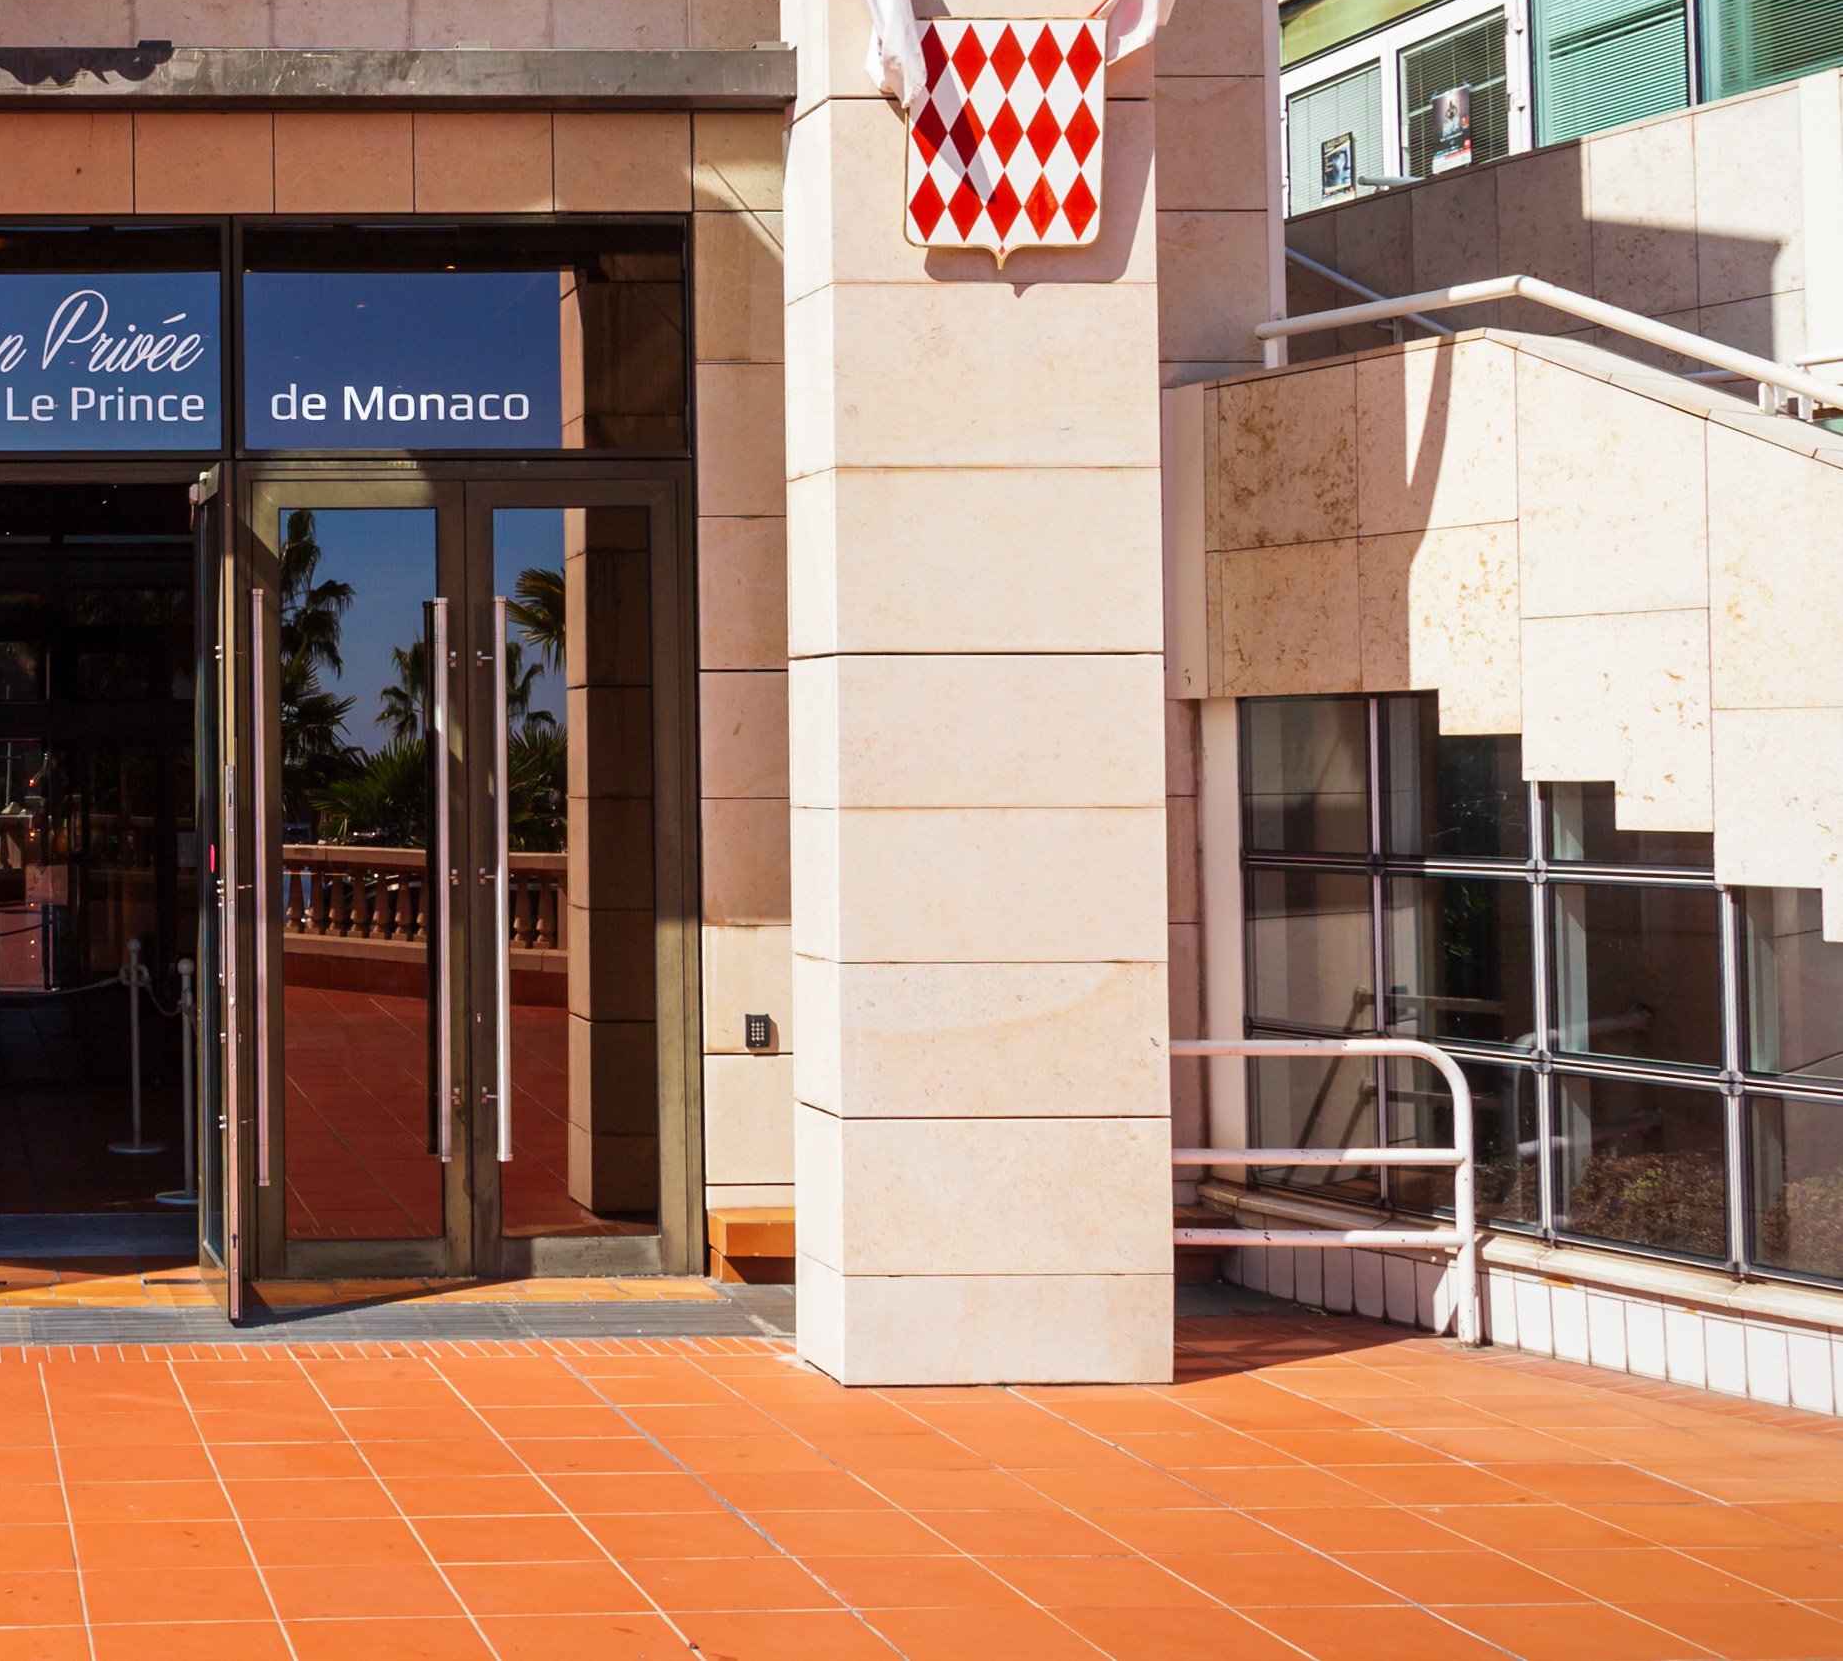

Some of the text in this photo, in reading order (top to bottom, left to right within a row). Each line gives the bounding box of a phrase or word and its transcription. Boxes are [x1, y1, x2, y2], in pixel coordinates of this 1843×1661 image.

[41, 289, 204, 373] Privée
[6, 386, 55, 422] Le
[70, 386, 205, 422] Prince
[271, 383, 530, 421] de Monaco
